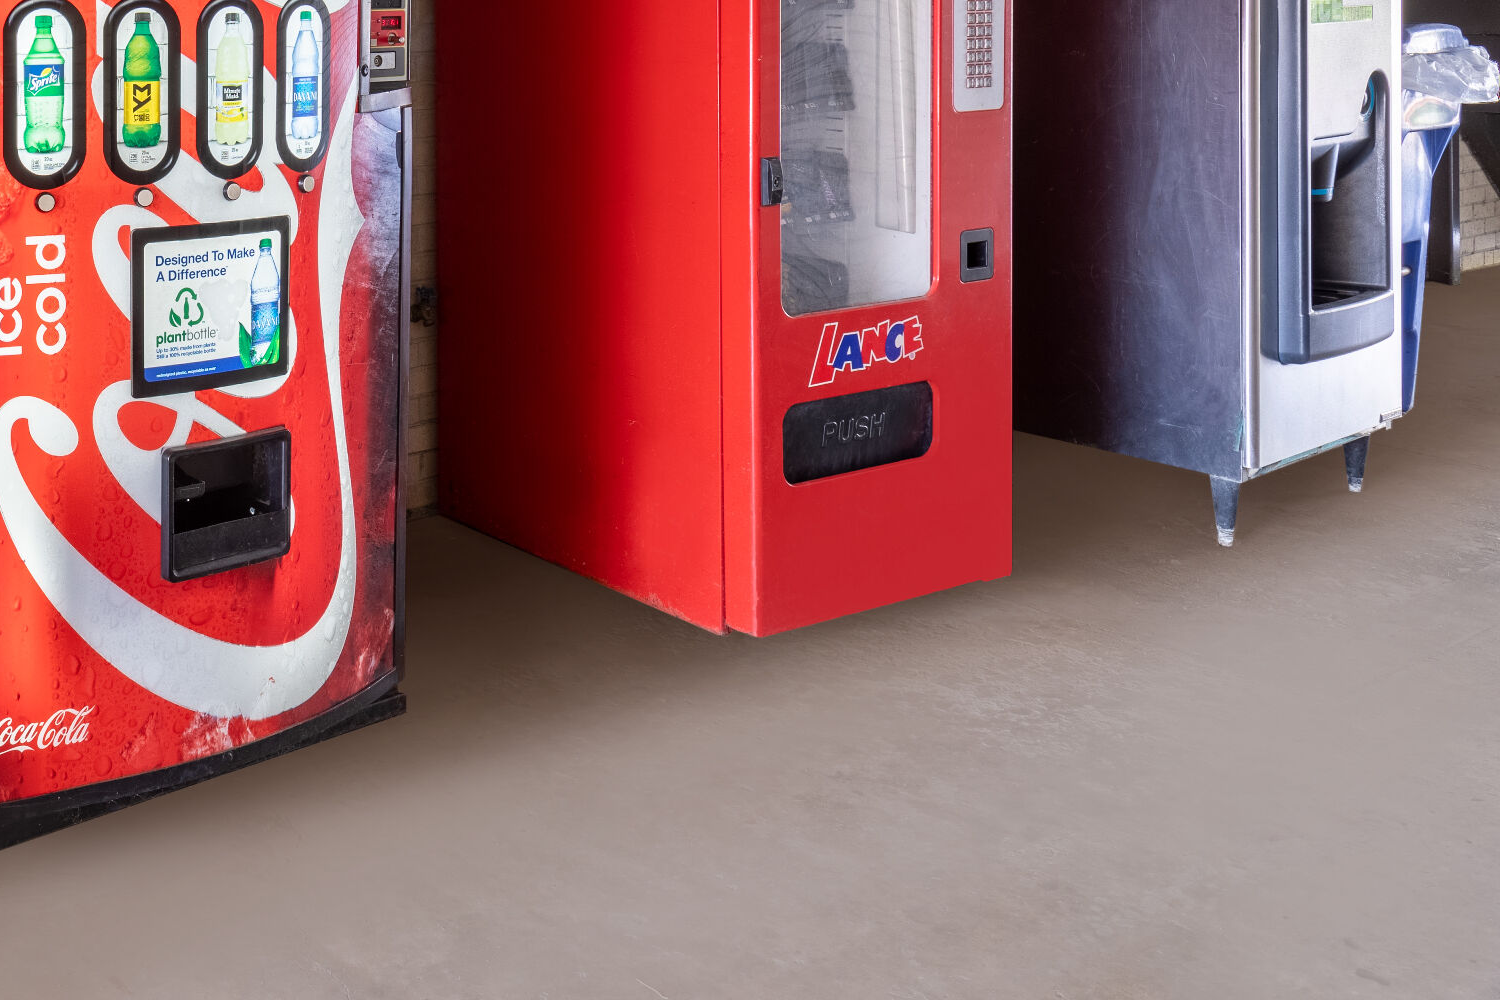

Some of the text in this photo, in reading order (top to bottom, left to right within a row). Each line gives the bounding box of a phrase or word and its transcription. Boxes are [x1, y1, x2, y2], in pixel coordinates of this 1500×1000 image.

[30, 72, 58, 92] Sprite
[155, 247, 255, 267] Designed To Make
[156, 267, 227, 282] A Difference
[25, 234, 67, 355] cold
[808, 315, 924, 388] LANCE
[821, 411, 886, 447] PUSH
